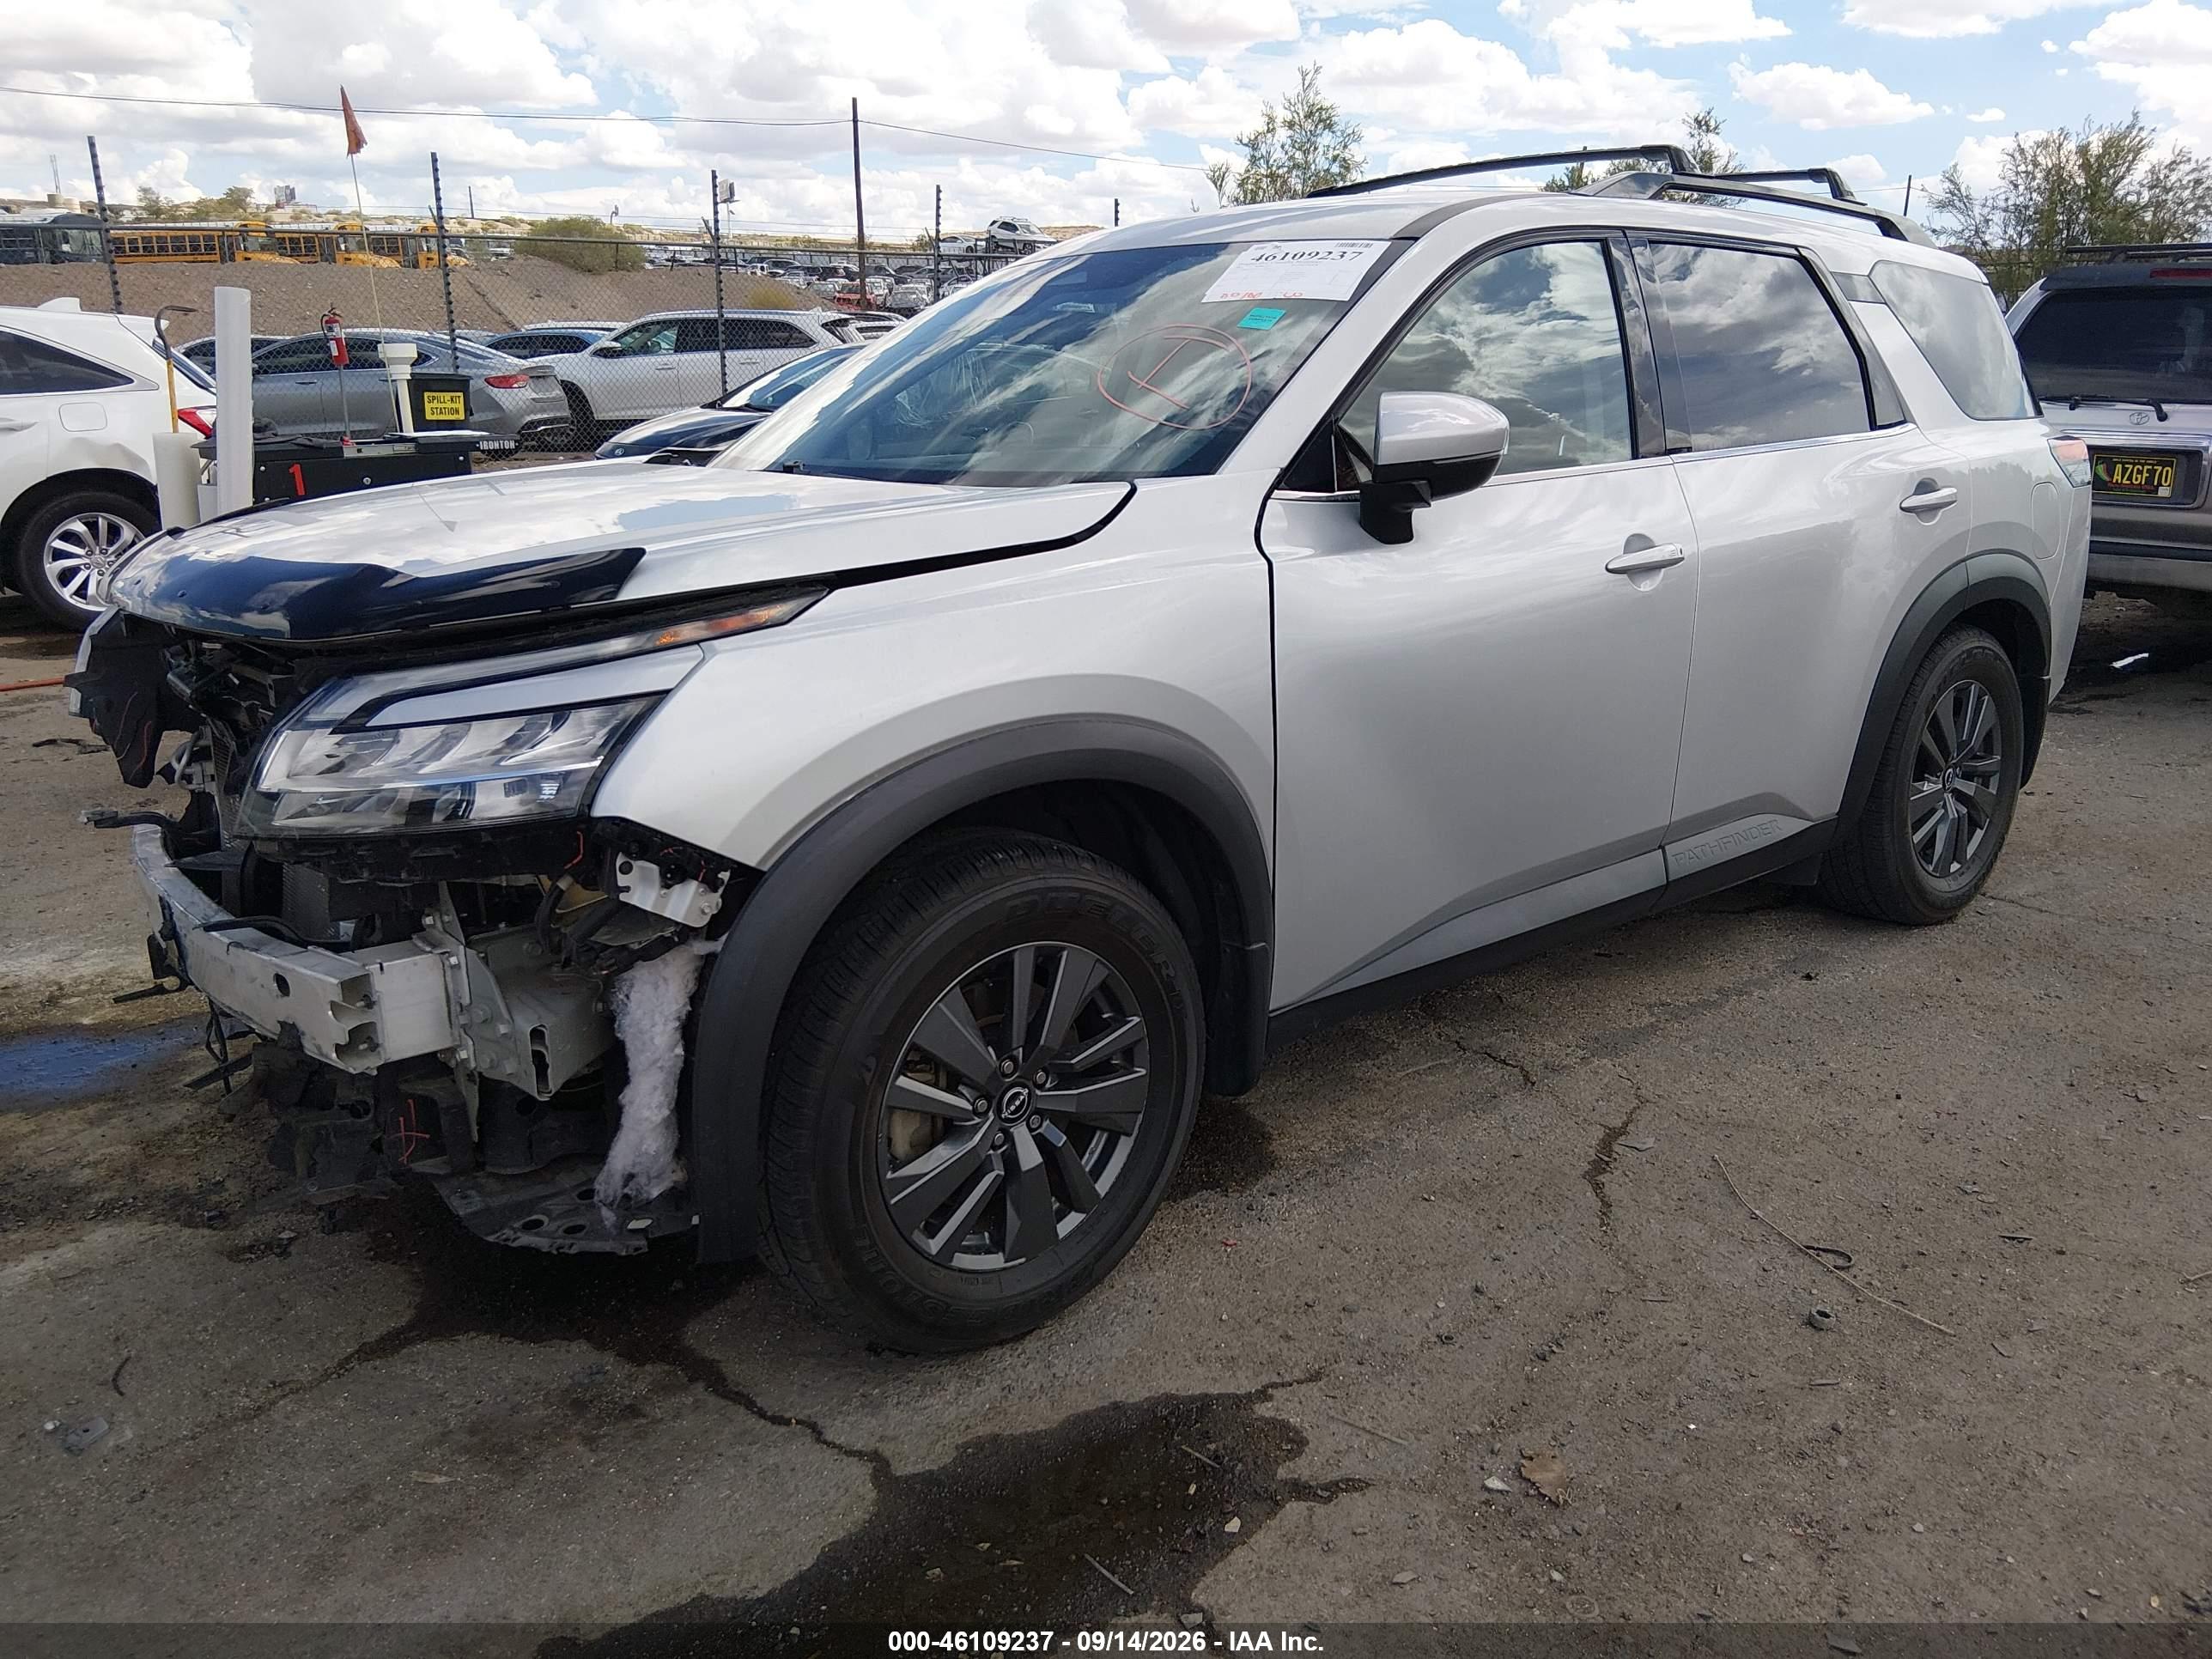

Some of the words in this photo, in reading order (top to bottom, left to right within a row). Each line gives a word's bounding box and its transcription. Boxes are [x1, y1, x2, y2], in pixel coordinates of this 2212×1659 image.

[1250, 251, 1364, 263] 46109237
[427, 395, 461, 405] SPILL-KIT
[430, 406, 460, 416] STATION
[479, 440, 515, 450] IRONTON
[289, 463, 307, 495] 1
[2112, 464, 2172, 486] AZGF70
[1672, 818, 1784, 867] PATHFINDER
[1003, 889, 1177, 981] DUELER
